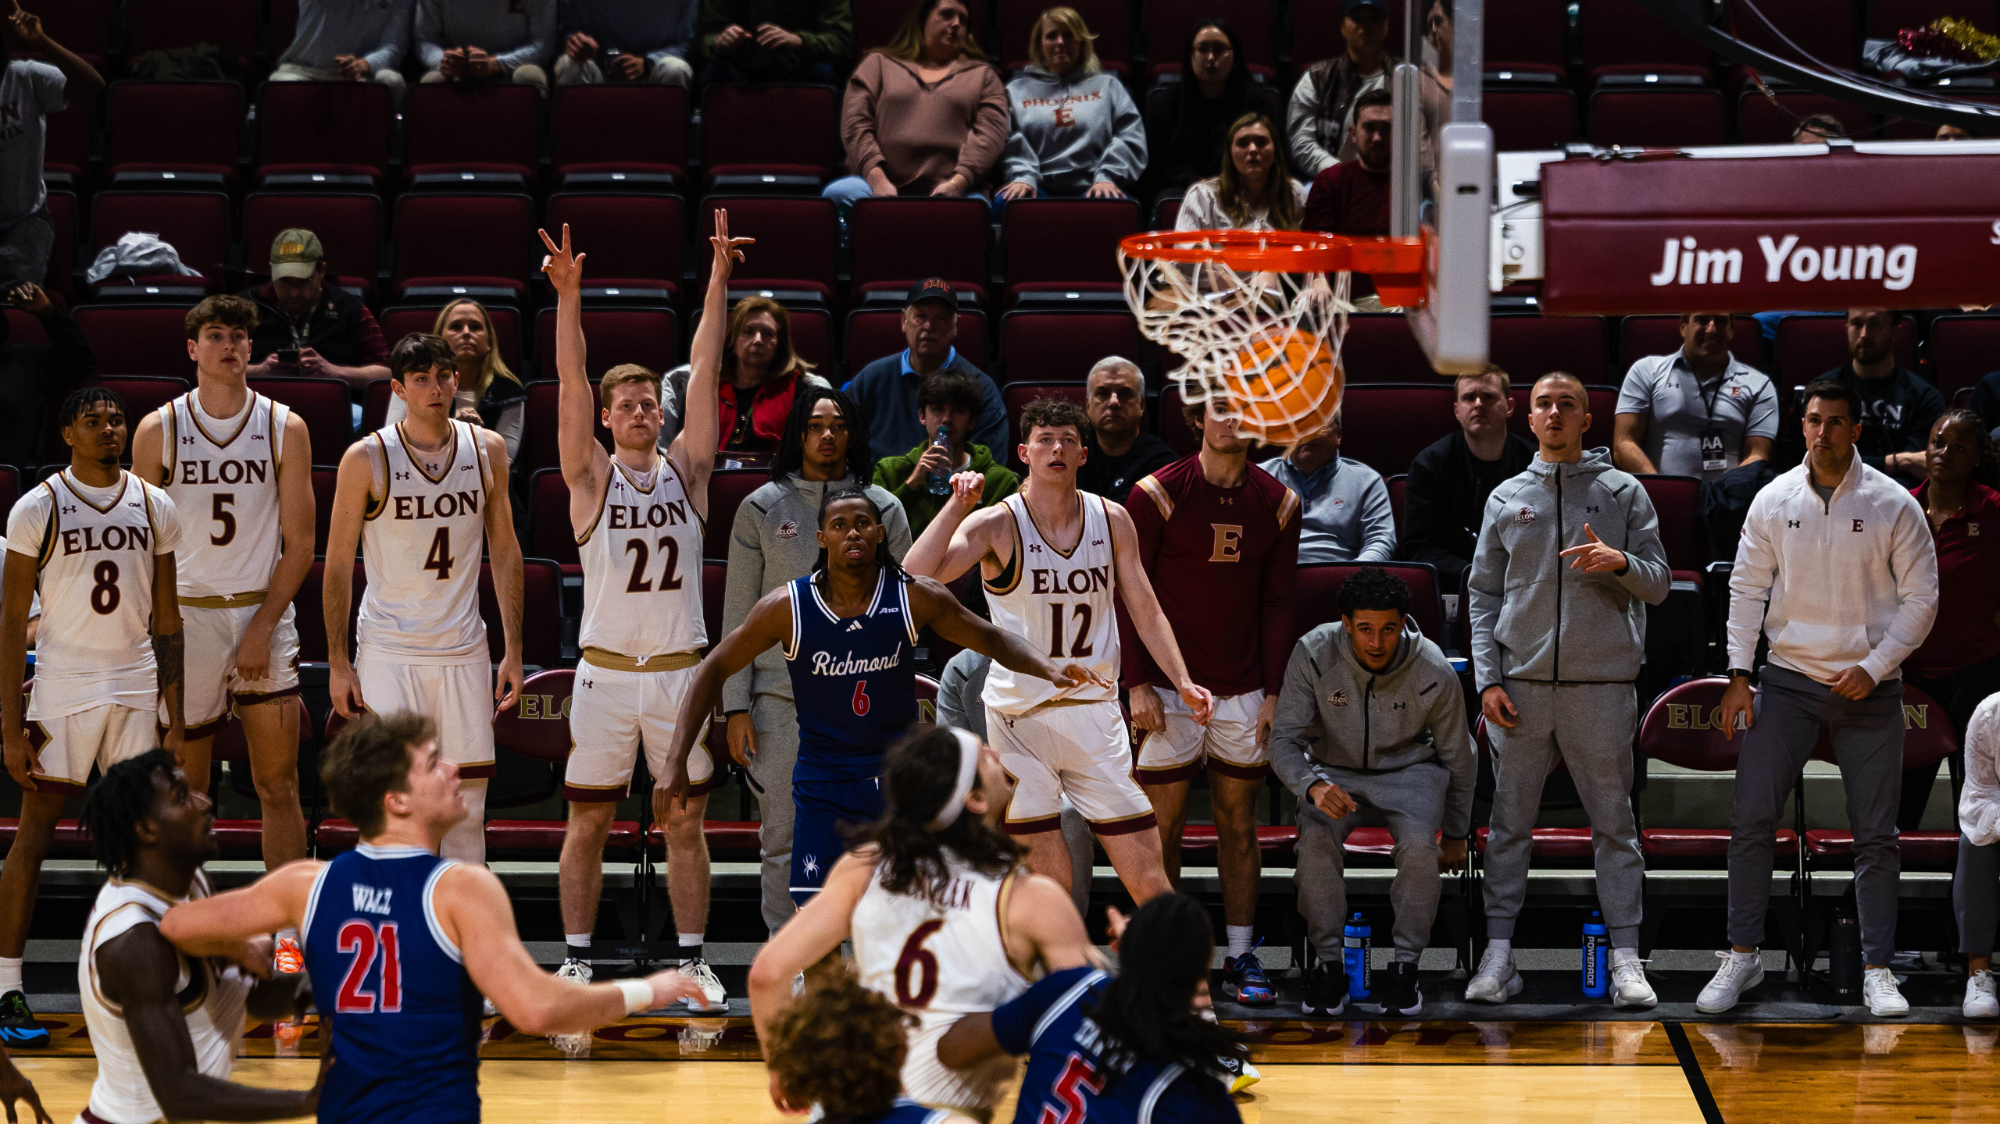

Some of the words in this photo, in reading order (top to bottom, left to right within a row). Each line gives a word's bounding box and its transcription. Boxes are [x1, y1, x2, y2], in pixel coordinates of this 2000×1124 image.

[1053, 107, 1076, 128] E
[1650, 235, 1743, 286] Jim
[1757, 234, 1918, 291] Young
[1702, 436, 1723, 450] AA
[180, 460, 268, 485] ELON
[210, 492, 237, 547] 5
[393, 489, 480, 520] ELON
[608, 499, 688, 530] ELON
[60, 525, 150, 557] ELON
[1207, 523, 1243, 563] E
[1852, 519, 1864, 533] E
[1967, 522, 1980, 537] E
[423, 526, 456, 581] 4
[624, 534, 684, 594] 22
[90, 559, 121, 616] 8
[1030, 564, 1109, 595] ELON
[1048, 602, 1094, 659] 12
[811, 640, 903, 677] Richmond
[851, 679, 871, 717] 6
[334, 916, 403, 1015] 21
[893, 918, 945, 1009] 6
[1586, 935, 1595, 987] POWERADE
[1036, 1049, 1108, 1124] 5
